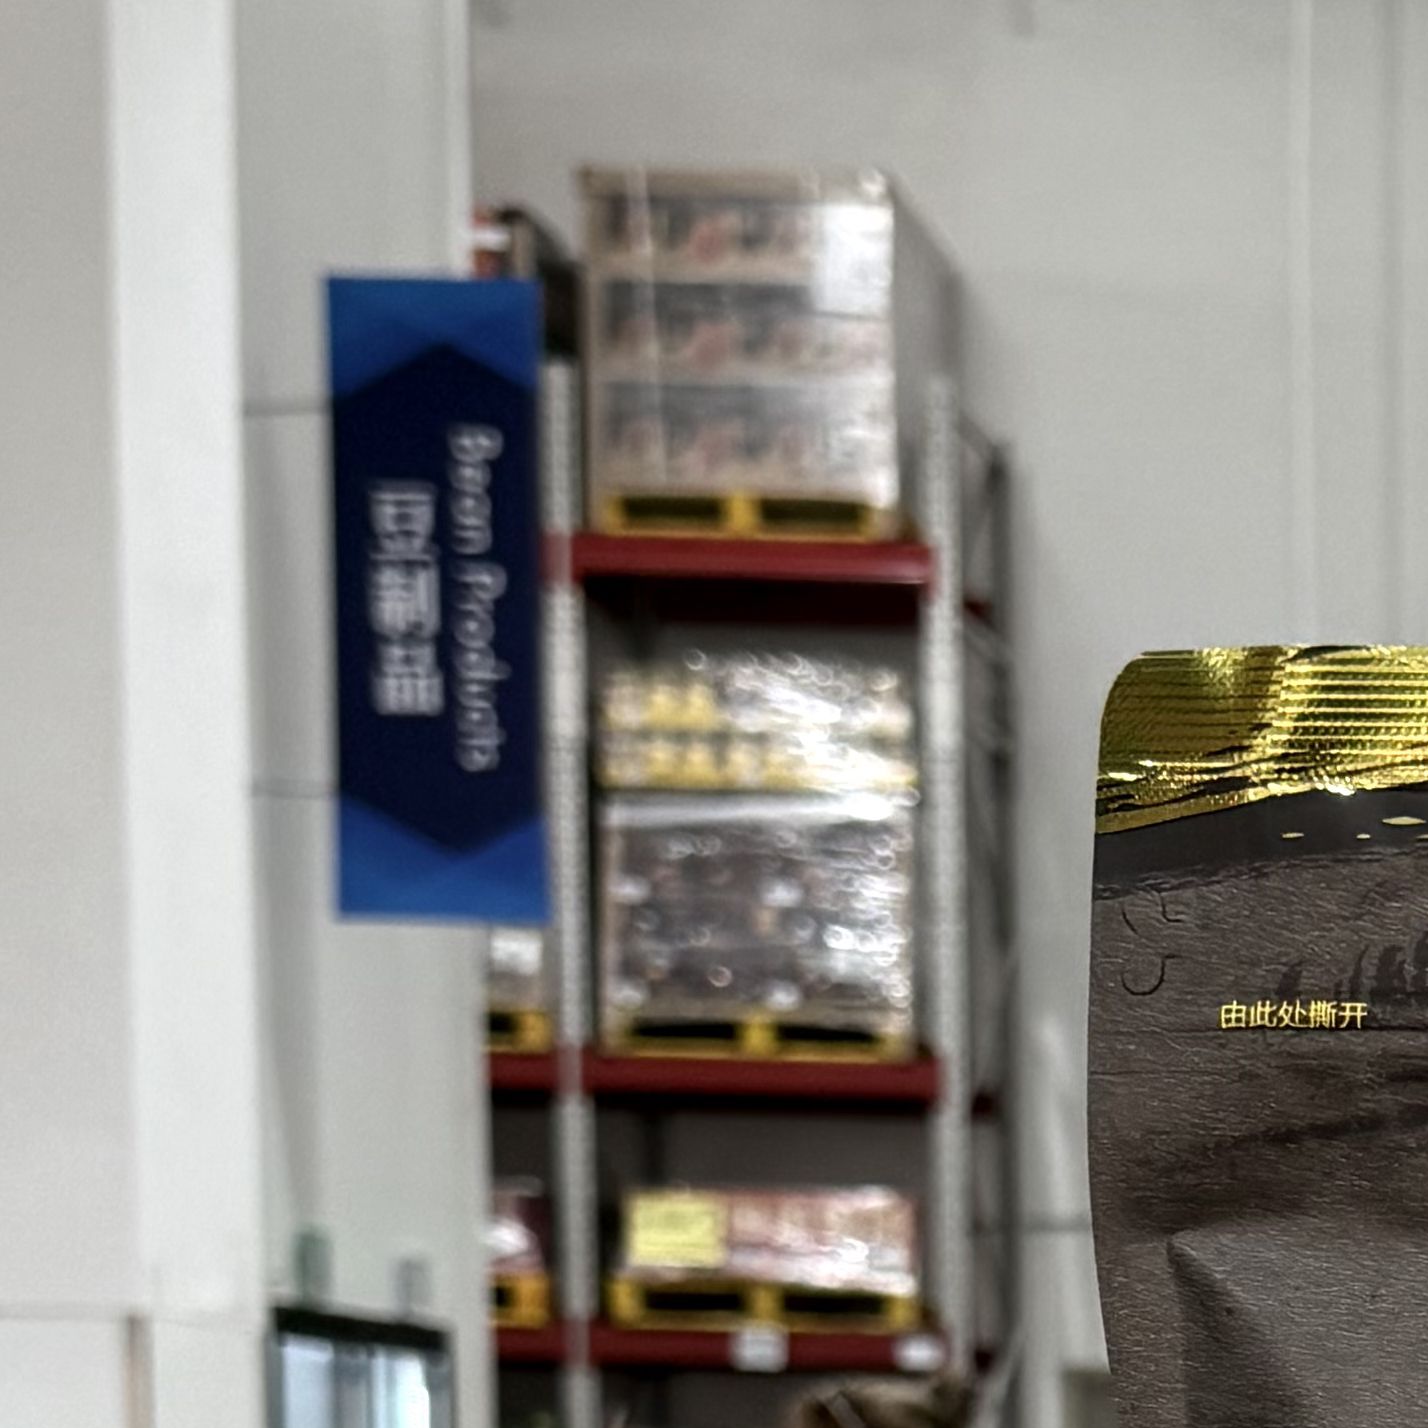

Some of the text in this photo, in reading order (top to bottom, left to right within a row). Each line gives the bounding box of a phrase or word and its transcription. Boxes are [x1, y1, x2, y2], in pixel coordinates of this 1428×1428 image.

[1219, 1000, 1368, 1030] 由此处撕开
